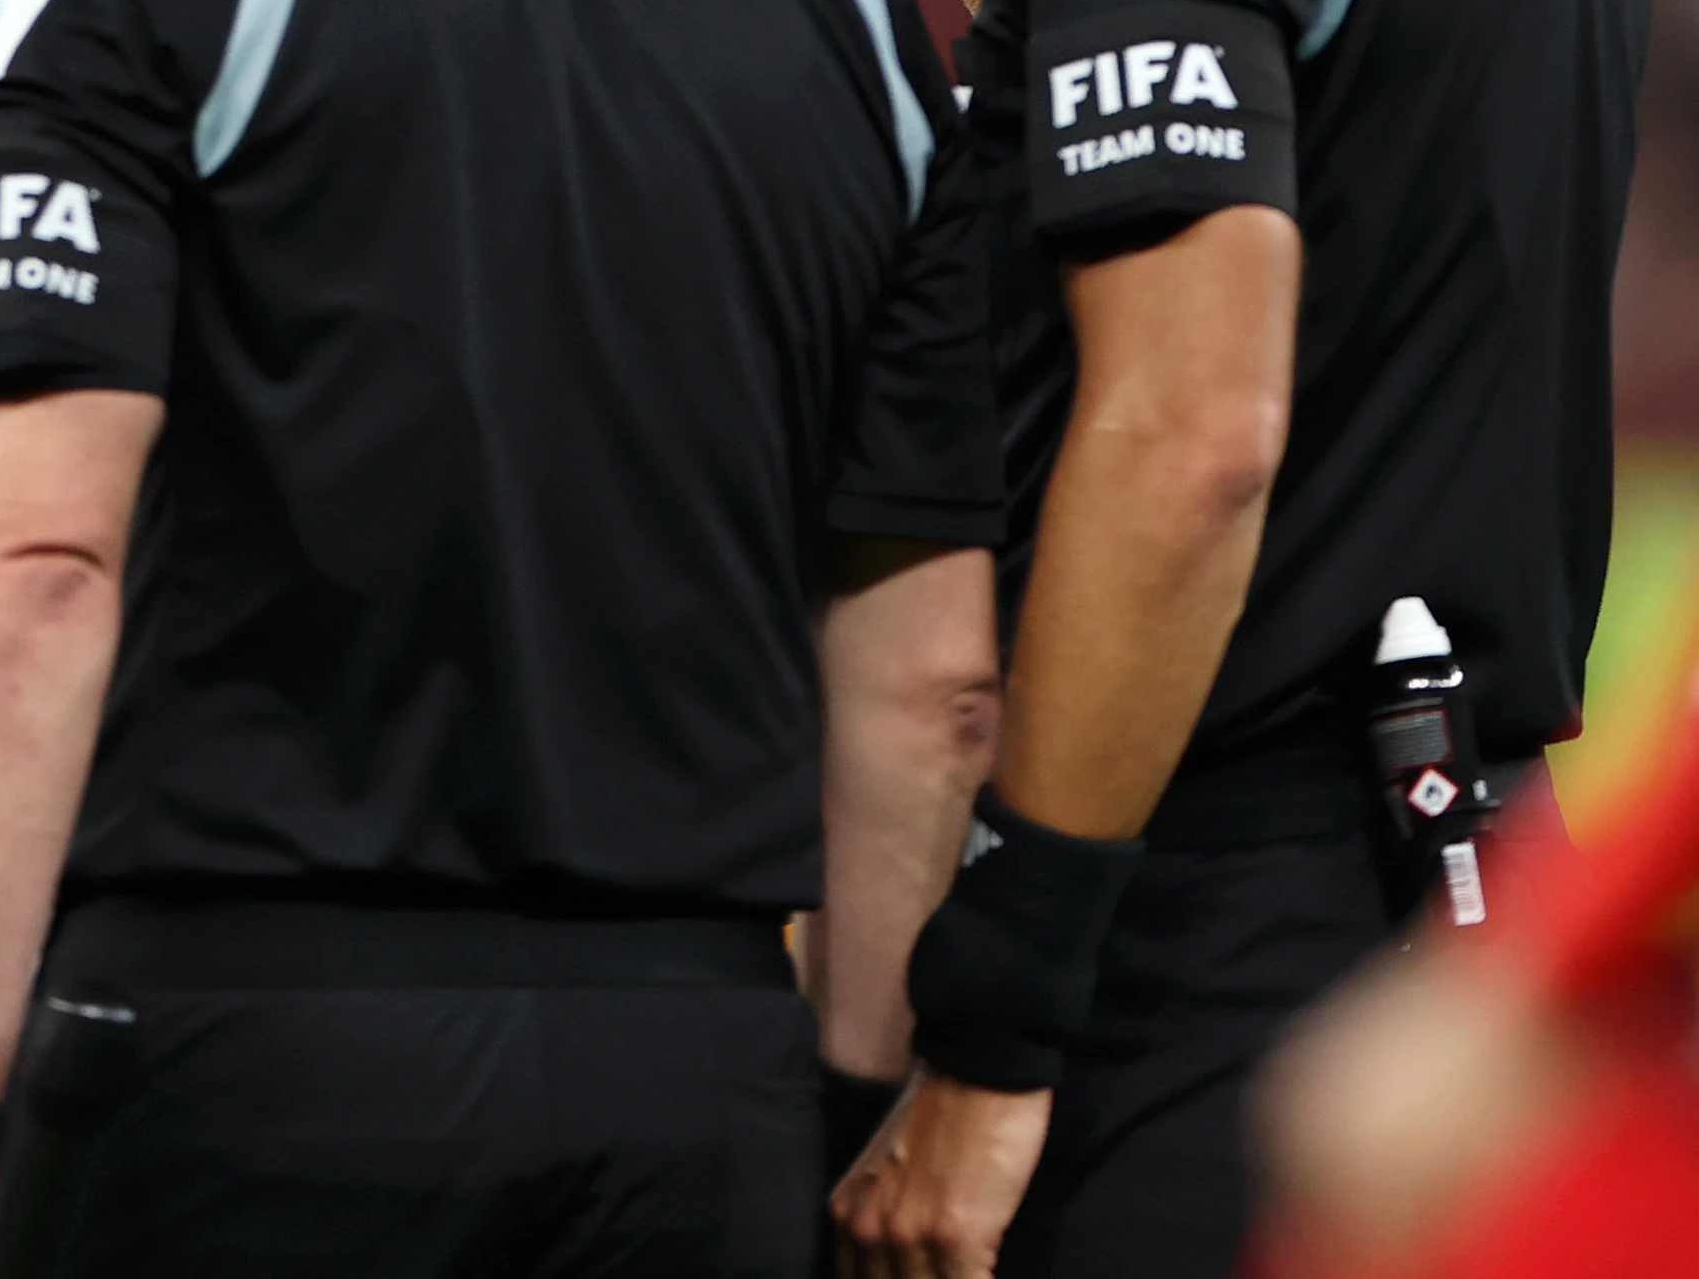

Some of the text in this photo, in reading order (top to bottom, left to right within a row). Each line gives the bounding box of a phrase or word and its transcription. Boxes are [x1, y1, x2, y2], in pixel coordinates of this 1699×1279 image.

[1048, 39, 1239, 129] FIFA
[1056, 121, 1247, 176] TEAM ONE
[14, 255, 99, 305] ONE
